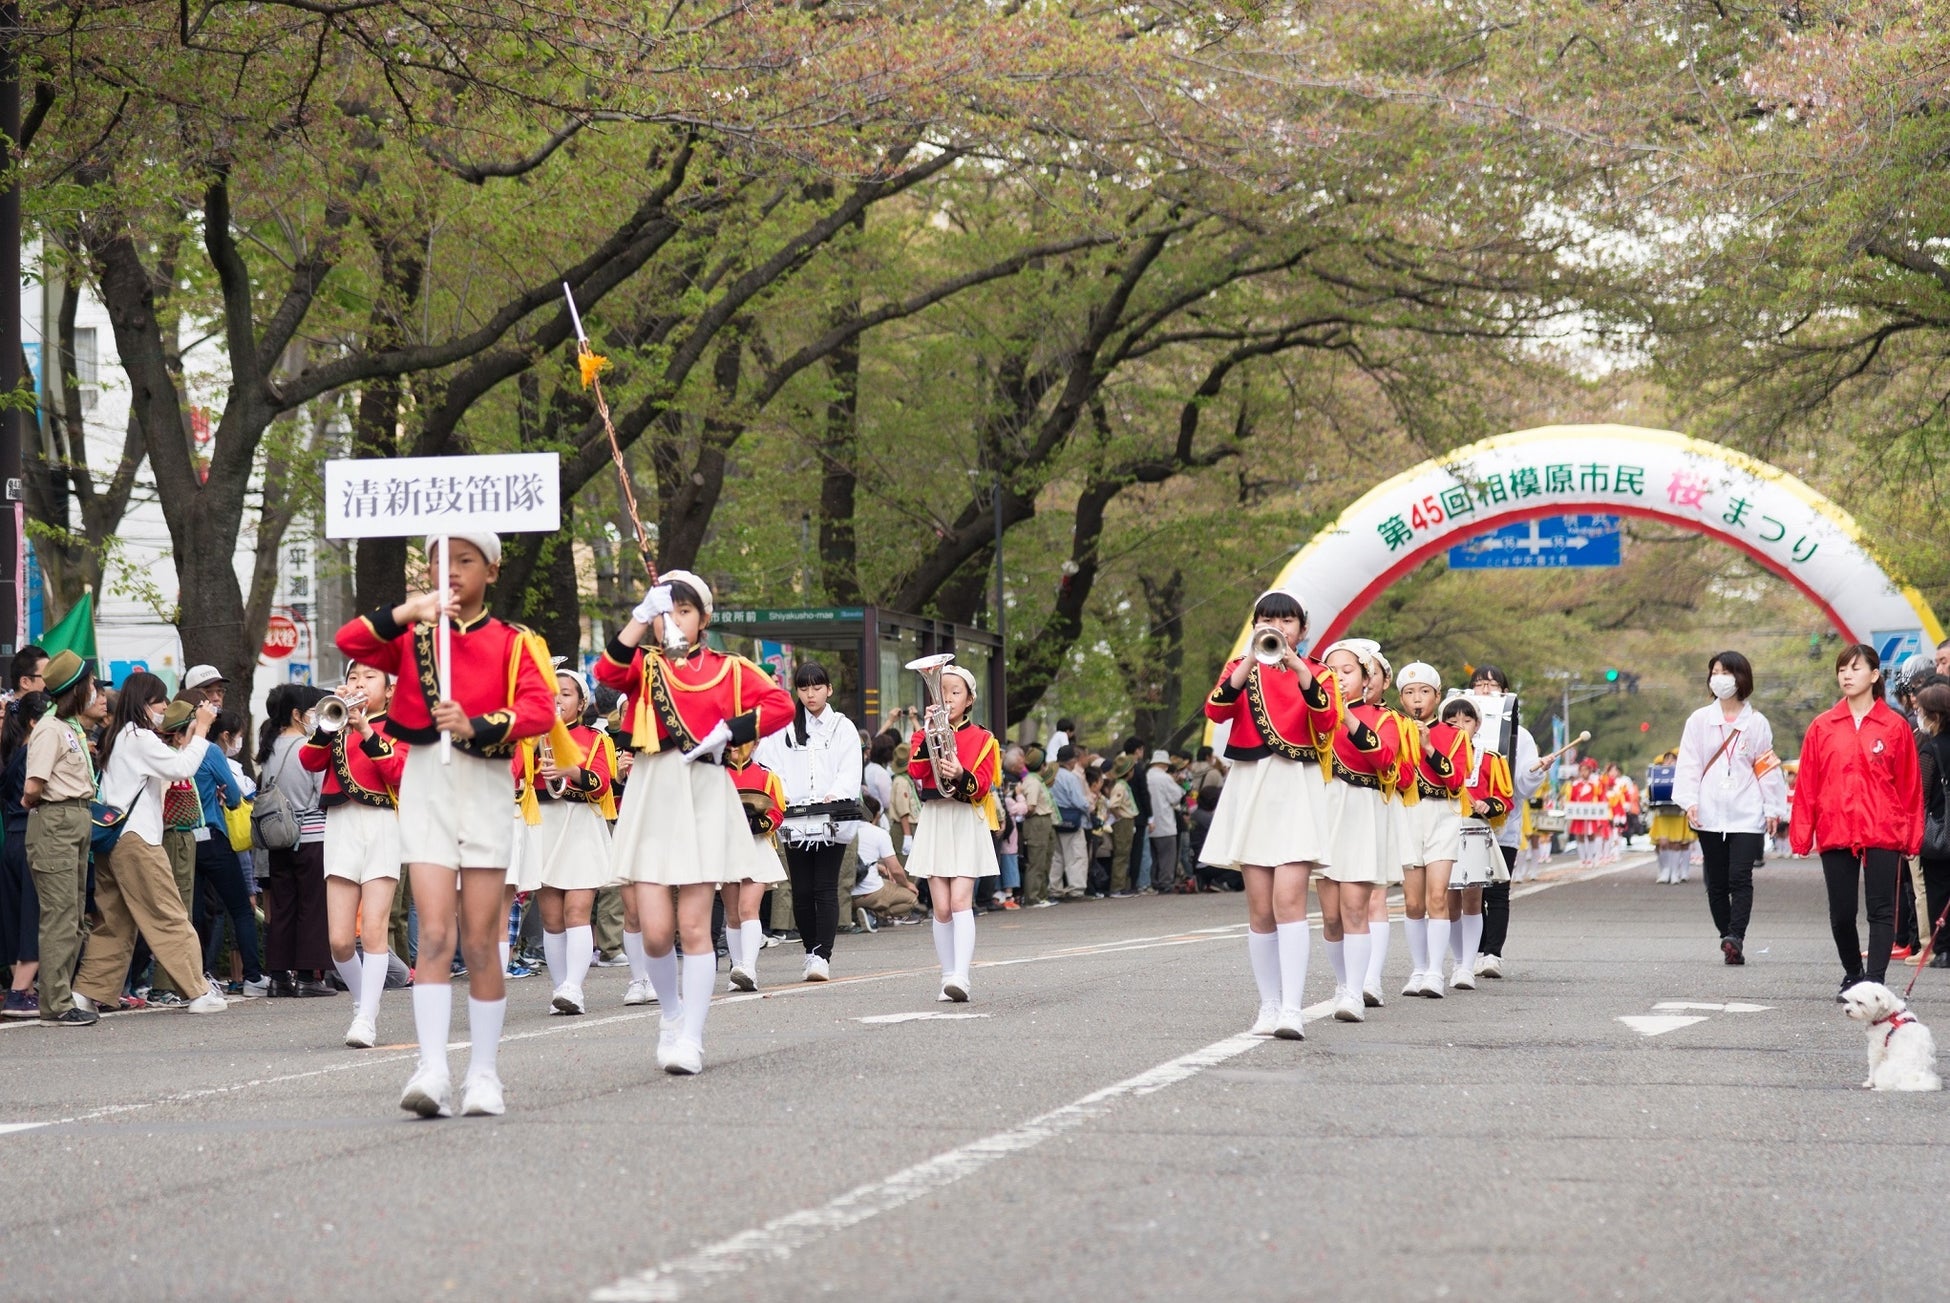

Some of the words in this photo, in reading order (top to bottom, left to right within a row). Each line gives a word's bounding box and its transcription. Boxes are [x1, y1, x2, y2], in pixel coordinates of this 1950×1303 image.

[342, 473, 545, 518] 清新鼓笛隊
[1722, 496, 1819, 564] まつり
[768, 611, 834, 621] Shiyakusho-mae
